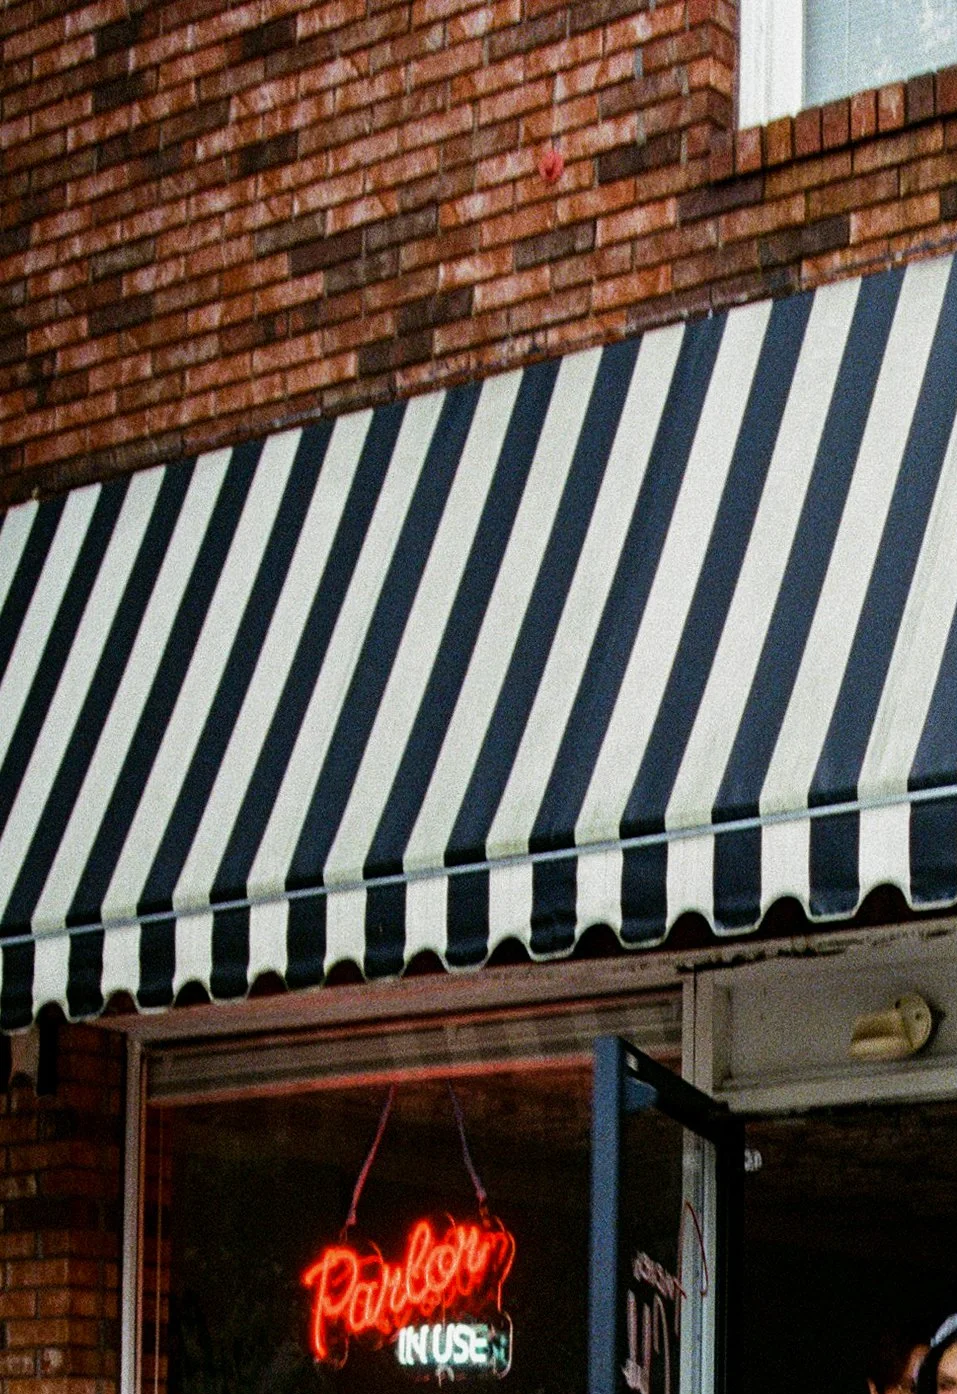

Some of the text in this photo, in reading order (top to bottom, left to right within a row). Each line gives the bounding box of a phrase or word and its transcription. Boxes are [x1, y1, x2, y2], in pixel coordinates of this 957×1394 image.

[302, 1220, 491, 1359] Parlor
[397, 1323, 489, 1365] IN USE
